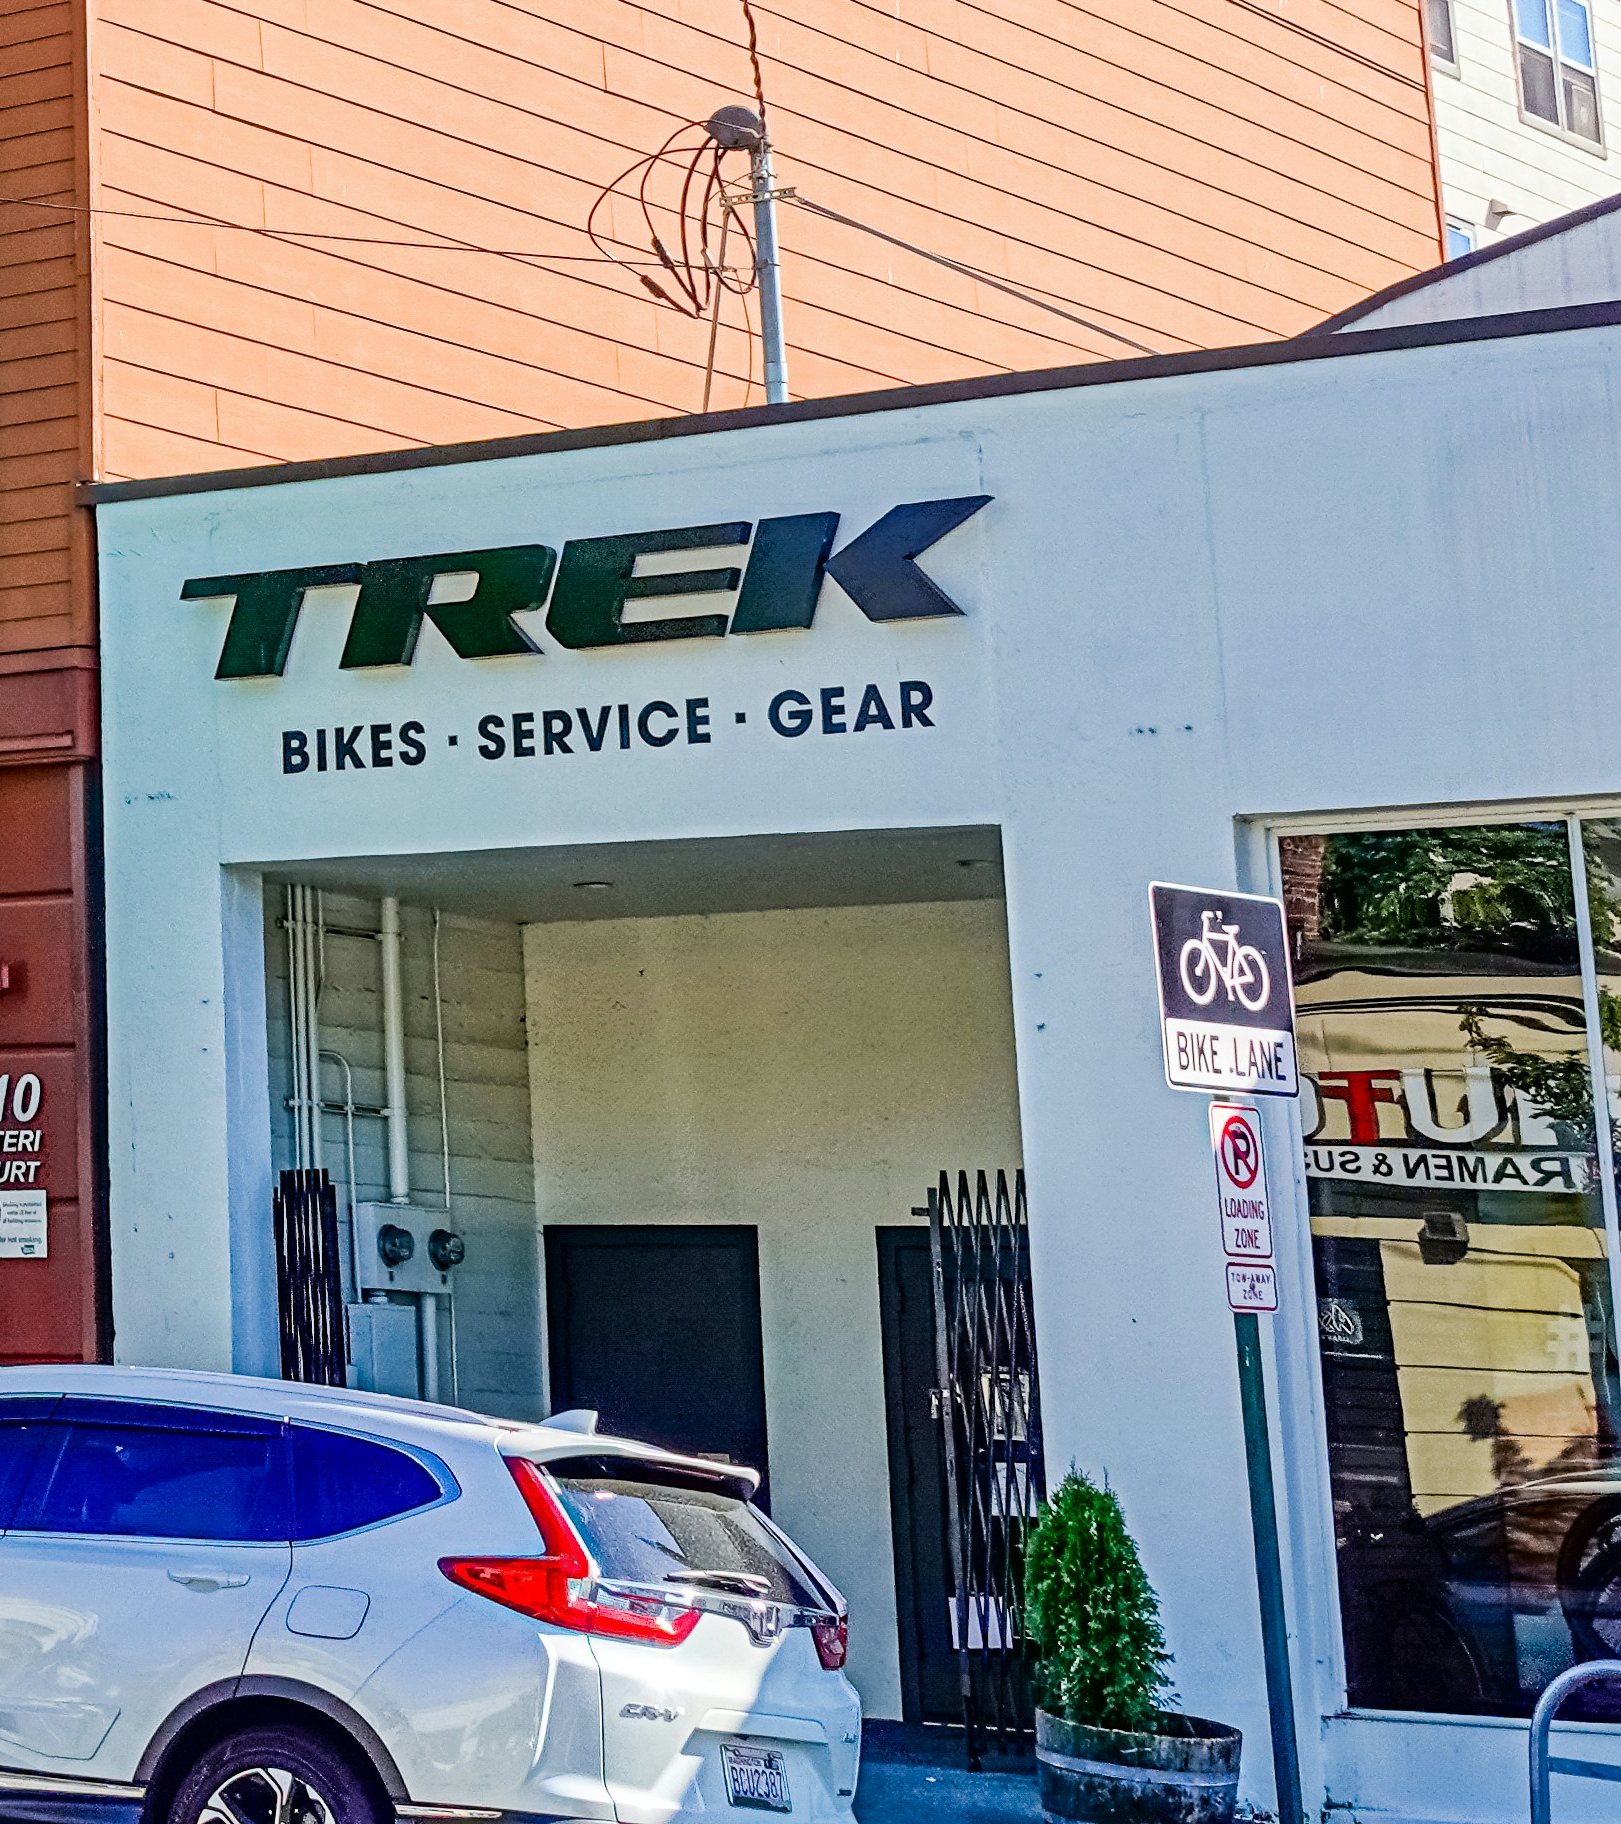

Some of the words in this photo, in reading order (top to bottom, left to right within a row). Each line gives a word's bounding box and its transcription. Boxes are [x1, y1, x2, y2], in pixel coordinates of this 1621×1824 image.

[179, 495, 995, 681] TREK
[282, 720, 426, 775] BIKES
[477, 697, 712, 760] SERVICE
[767, 679, 935, 739] GEAR
[1177, 1031, 1222, 1074] BIKE
[1233, 1037, 1287, 1081] LANE
[1224, 1197, 1265, 1221] LOADING
[1234, 1228, 1261, 1250] ZONE
[1231, 1272, 1271, 1284] TOW-AWAY
[1243, 1289, 1264, 1301] ZONE
[731, 1766, 784, 1801] BCU2387
